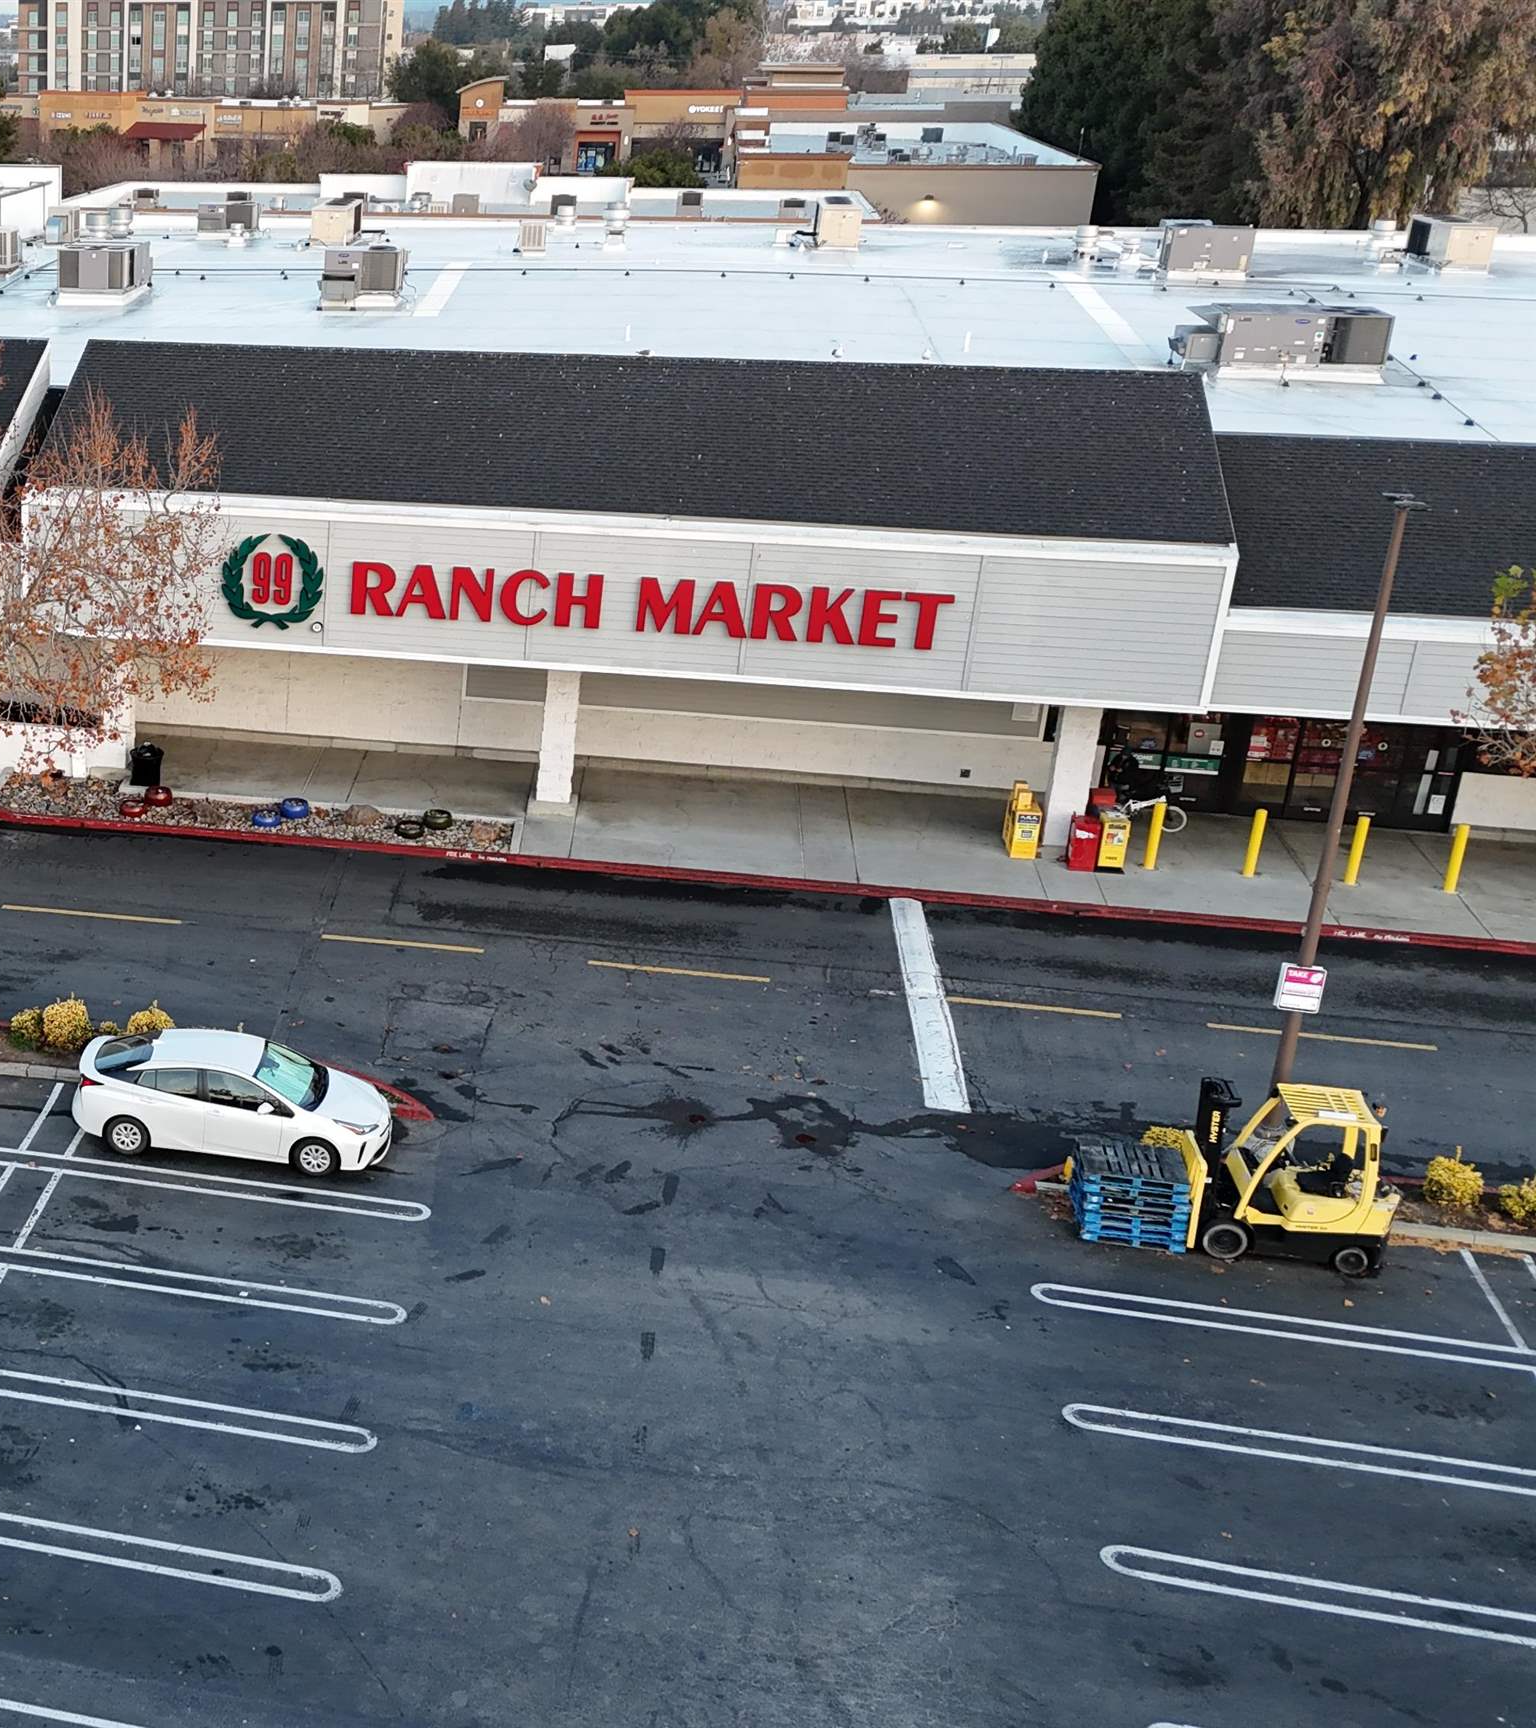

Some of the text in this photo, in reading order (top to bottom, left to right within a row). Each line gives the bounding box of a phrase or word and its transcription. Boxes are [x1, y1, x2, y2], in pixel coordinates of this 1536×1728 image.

[251, 552, 294, 606] 99
[350, 561, 956, 651] RANCH MARKET
[1208, 1110, 1222, 1144] HYSTER
